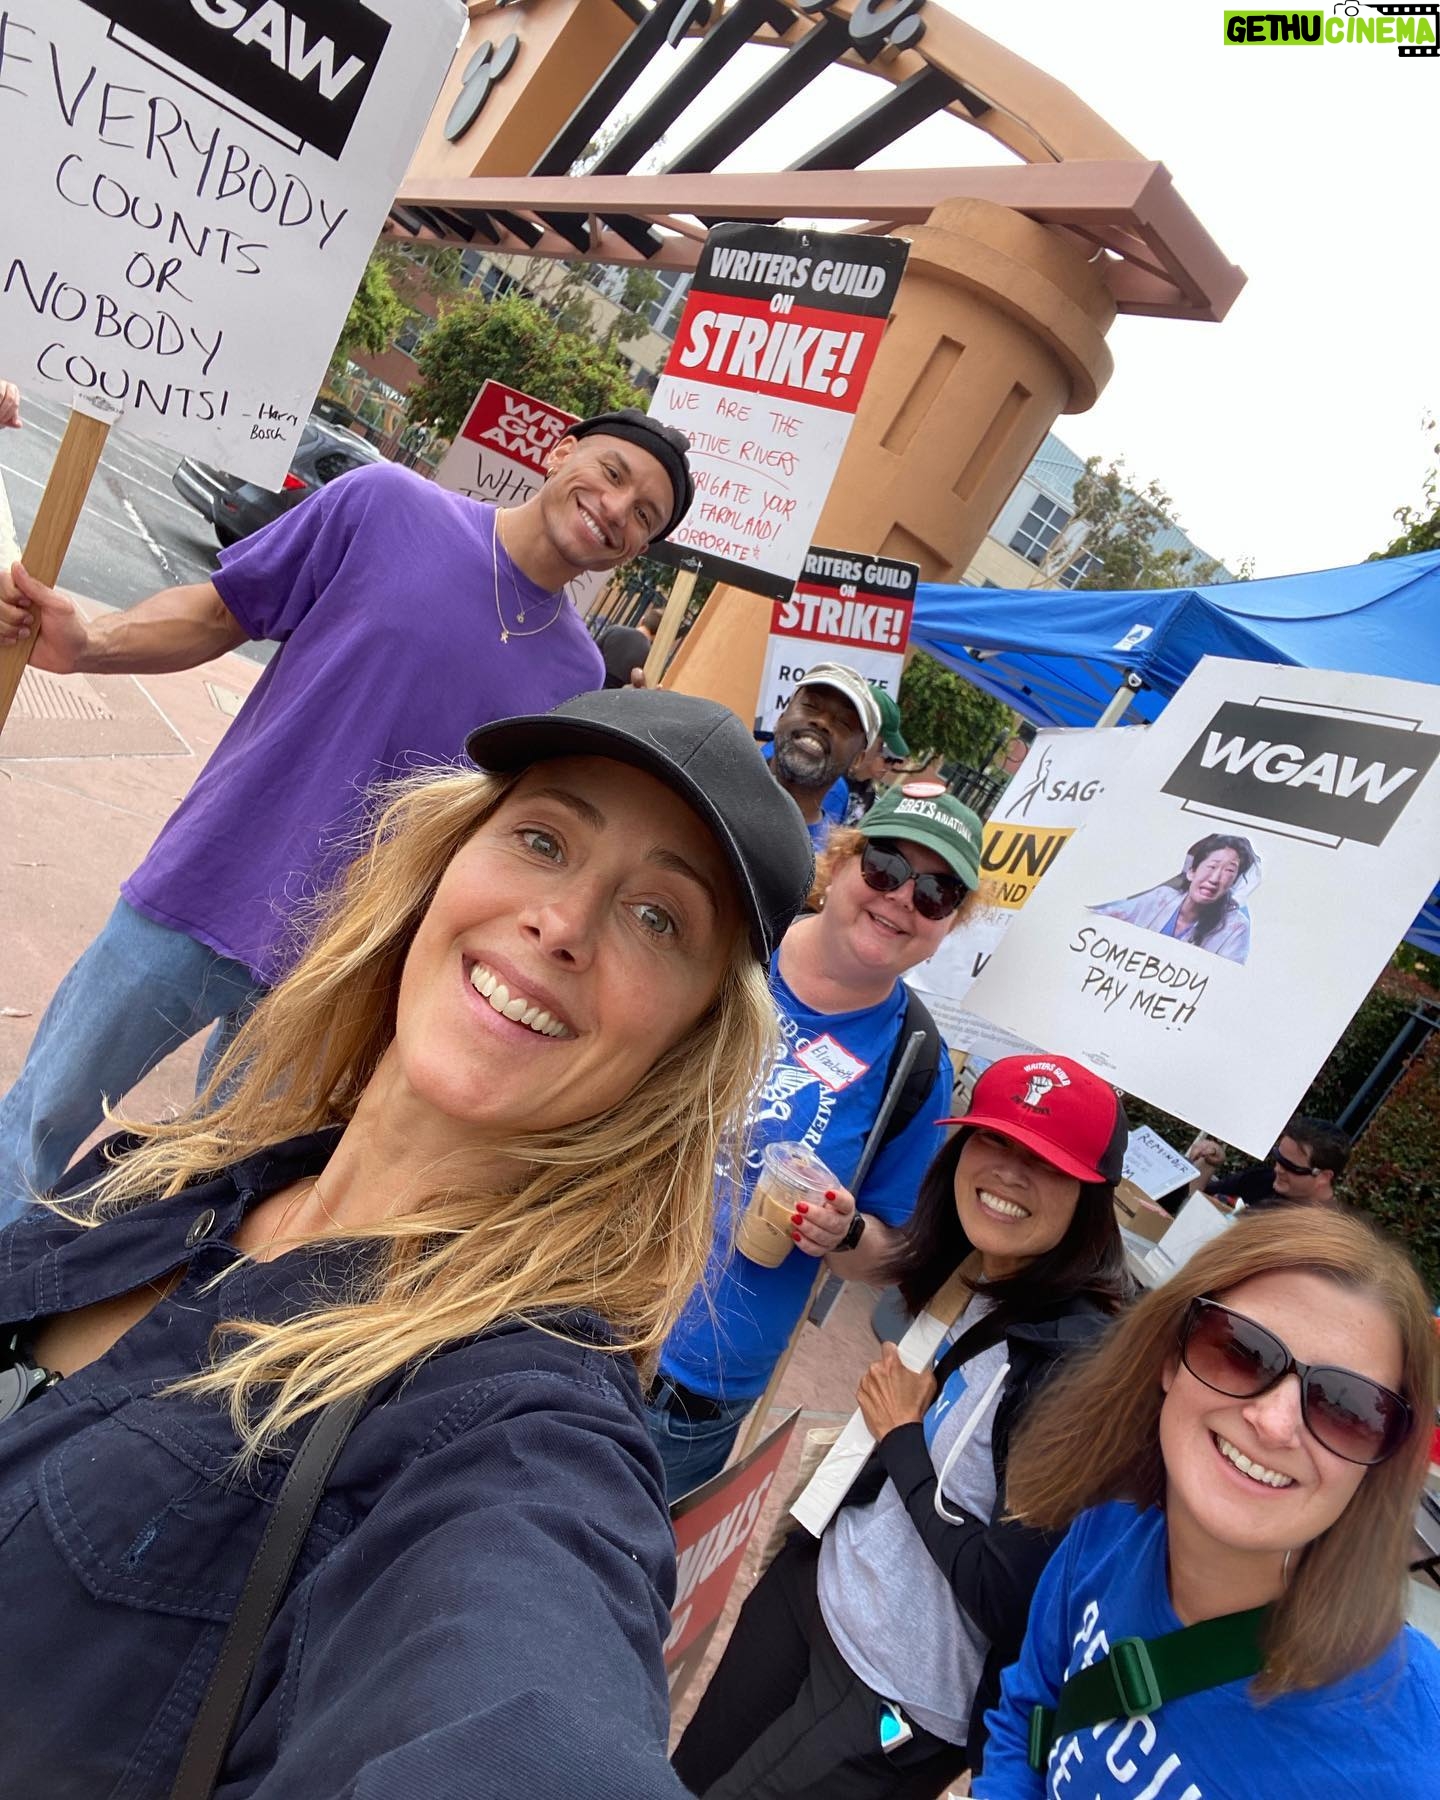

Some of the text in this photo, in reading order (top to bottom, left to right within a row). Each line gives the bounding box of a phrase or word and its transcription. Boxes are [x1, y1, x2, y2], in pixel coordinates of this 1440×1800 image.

[0, 12, 348, 249] EVERYBODY
[56, 154, 270, 274] COUNTS
[126, 251, 193, 303] OR
[709, 247, 887, 299] WRITERS GUILD
[4, 259, 223, 376] NOBODY
[769, 293, 795, 315] ON
[680, 310, 865, 398] STRIKE!
[37, 343, 229, 430] COUNTS!
[249, 425, 287, 442] Bosch
[668, 424, 731, 454] ATIVE
[670, 389, 803, 438] WE ARE THE
[691, 471, 797, 521] RRIGATE YOUR
[699, 502, 783, 548] FARMLAND!
[804, 553, 912, 590] RITERS GUILD
[839, 583, 858, 598] ON
[778, 592, 905, 647] STRIKE!
[1199, 730, 1418, 805] WGAW
[980, 830, 1068, 878] UNI
[1069, 927, 1210, 1008] SOMEBODY
[1081, 965, 1197, 1032] PAY ME!!
[801, 1083, 837, 1152] AMERI
